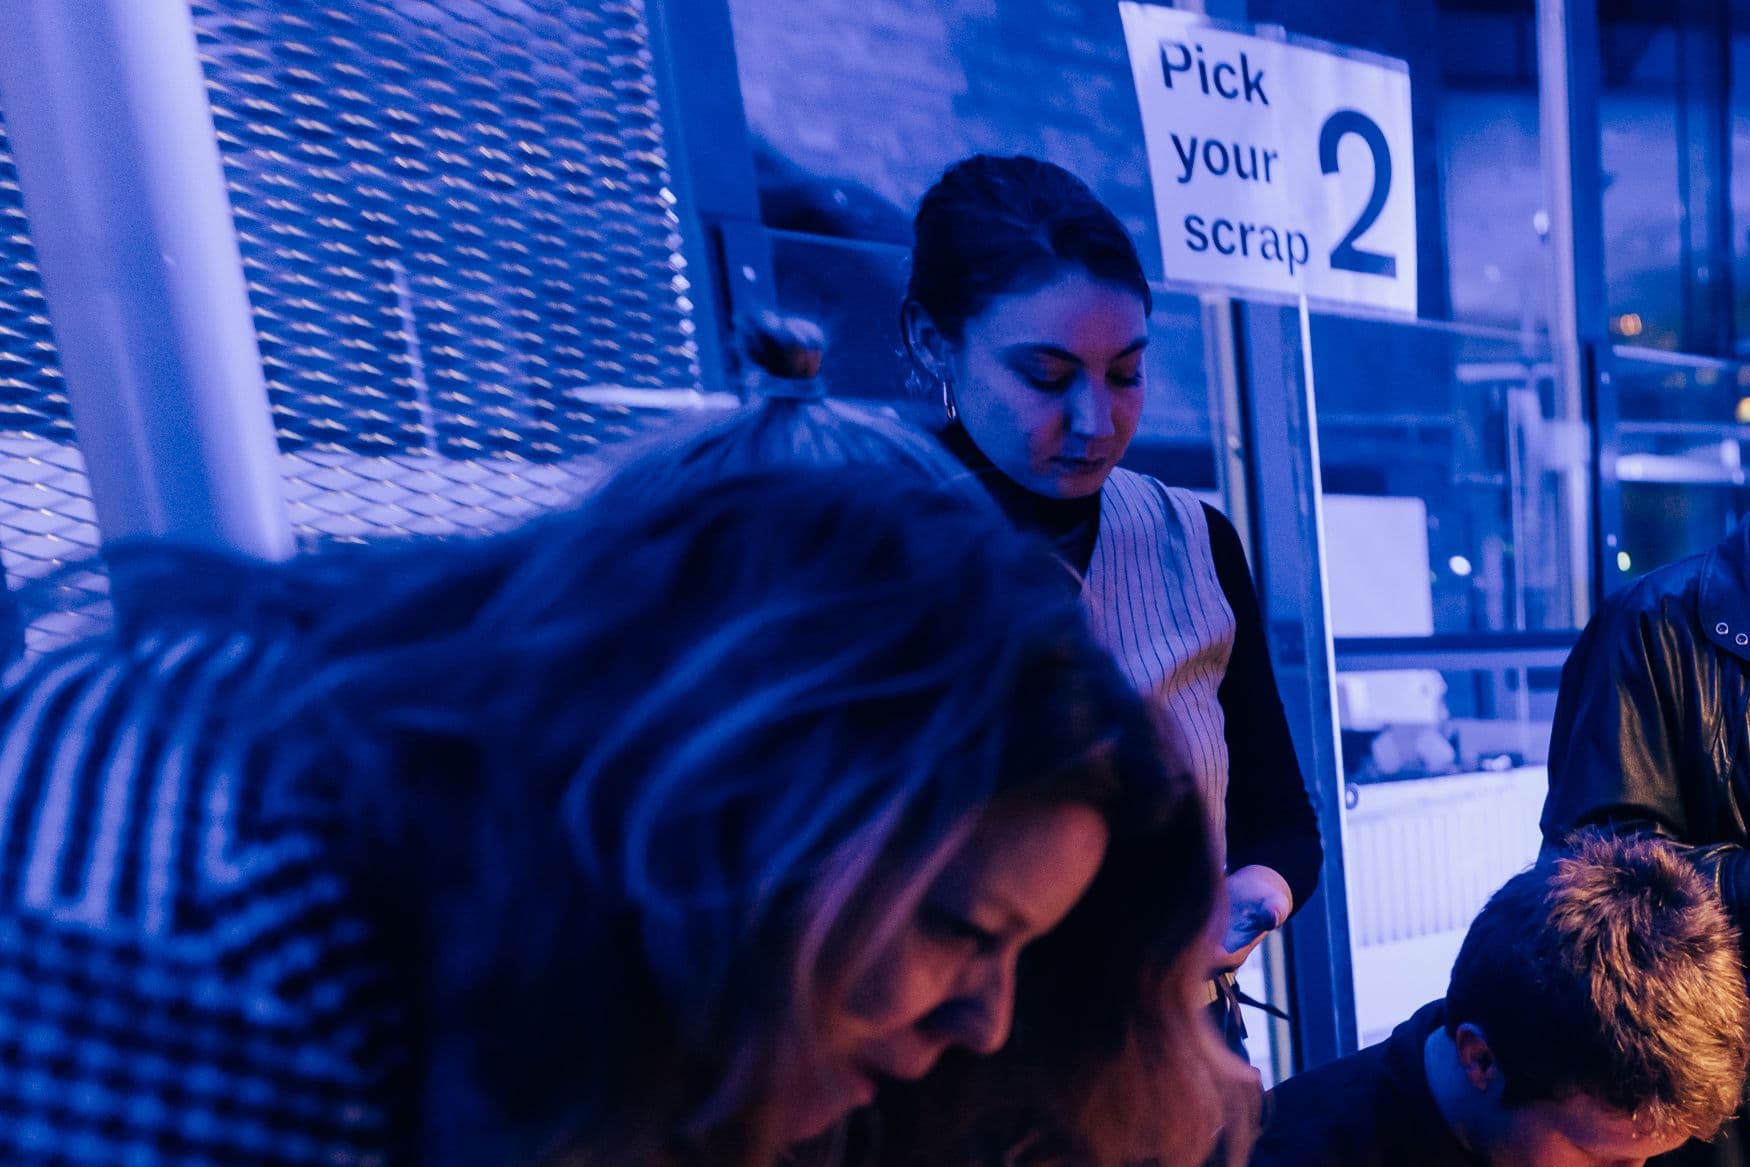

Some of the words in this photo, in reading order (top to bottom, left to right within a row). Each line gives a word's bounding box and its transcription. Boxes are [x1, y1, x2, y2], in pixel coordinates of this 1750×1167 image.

[1160, 42, 1270, 106] Pick
[1170, 133, 1279, 184] your
[1318, 109, 1397, 278] 2
[1184, 214, 1309, 276] scrap
